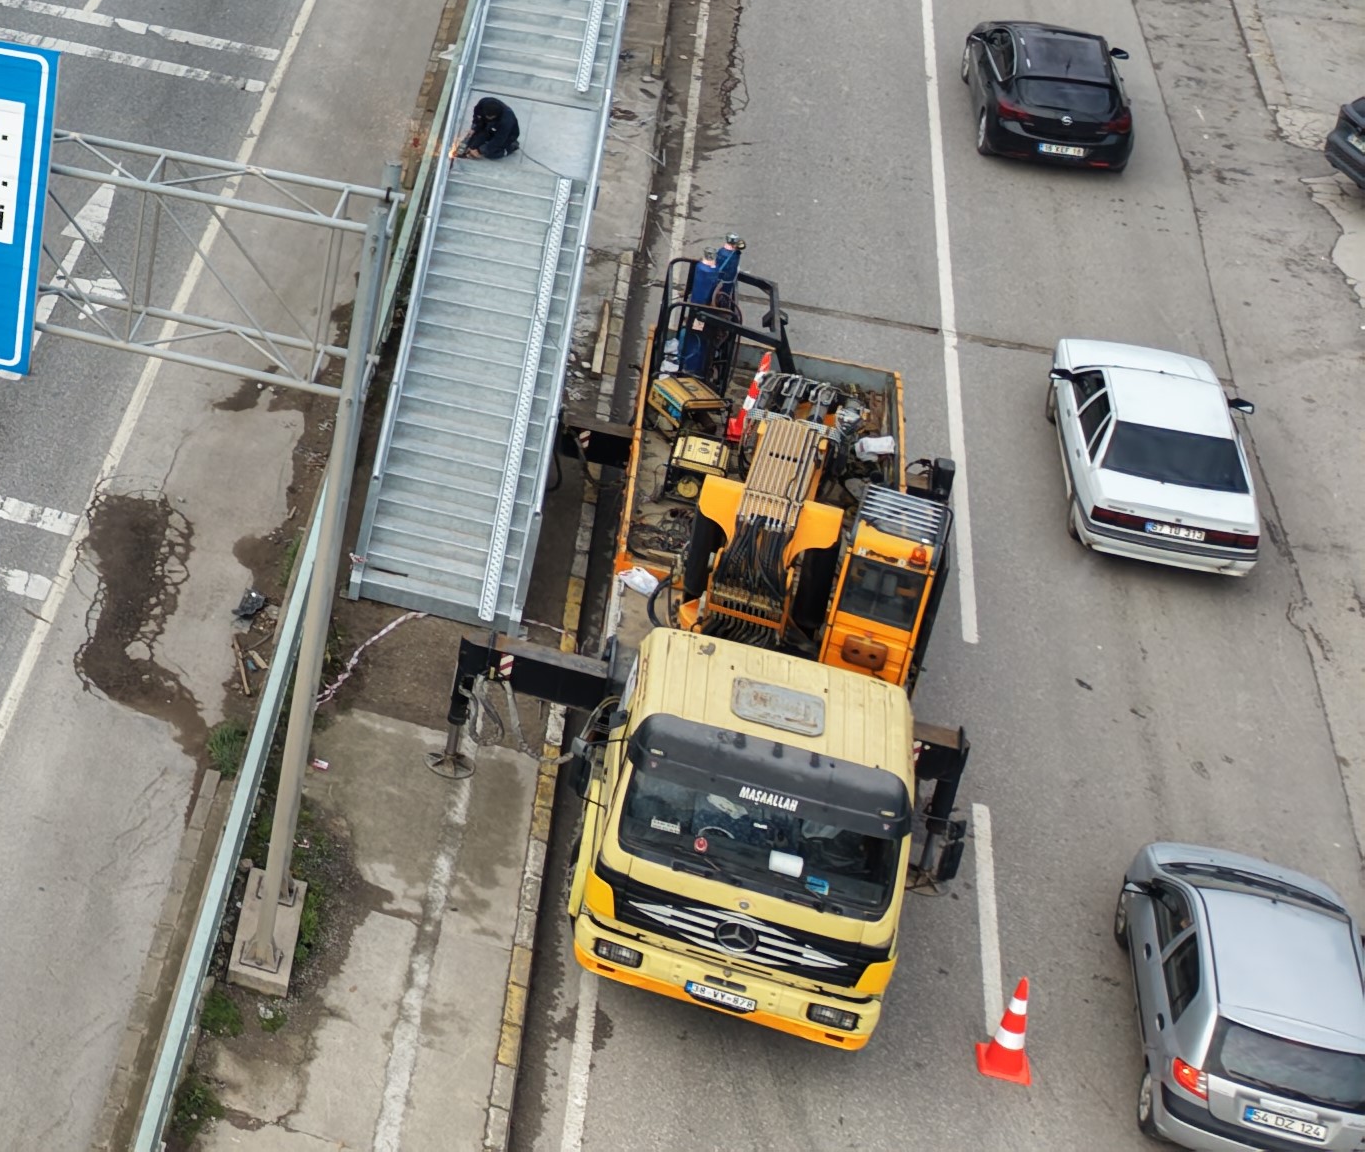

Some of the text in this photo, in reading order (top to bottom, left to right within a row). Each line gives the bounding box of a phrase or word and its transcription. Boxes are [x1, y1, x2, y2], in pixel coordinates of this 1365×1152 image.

[739, 786, 799, 813] MAŞAALLAH
[1253, 1110, 1321, 1137] 54 DZ 124
